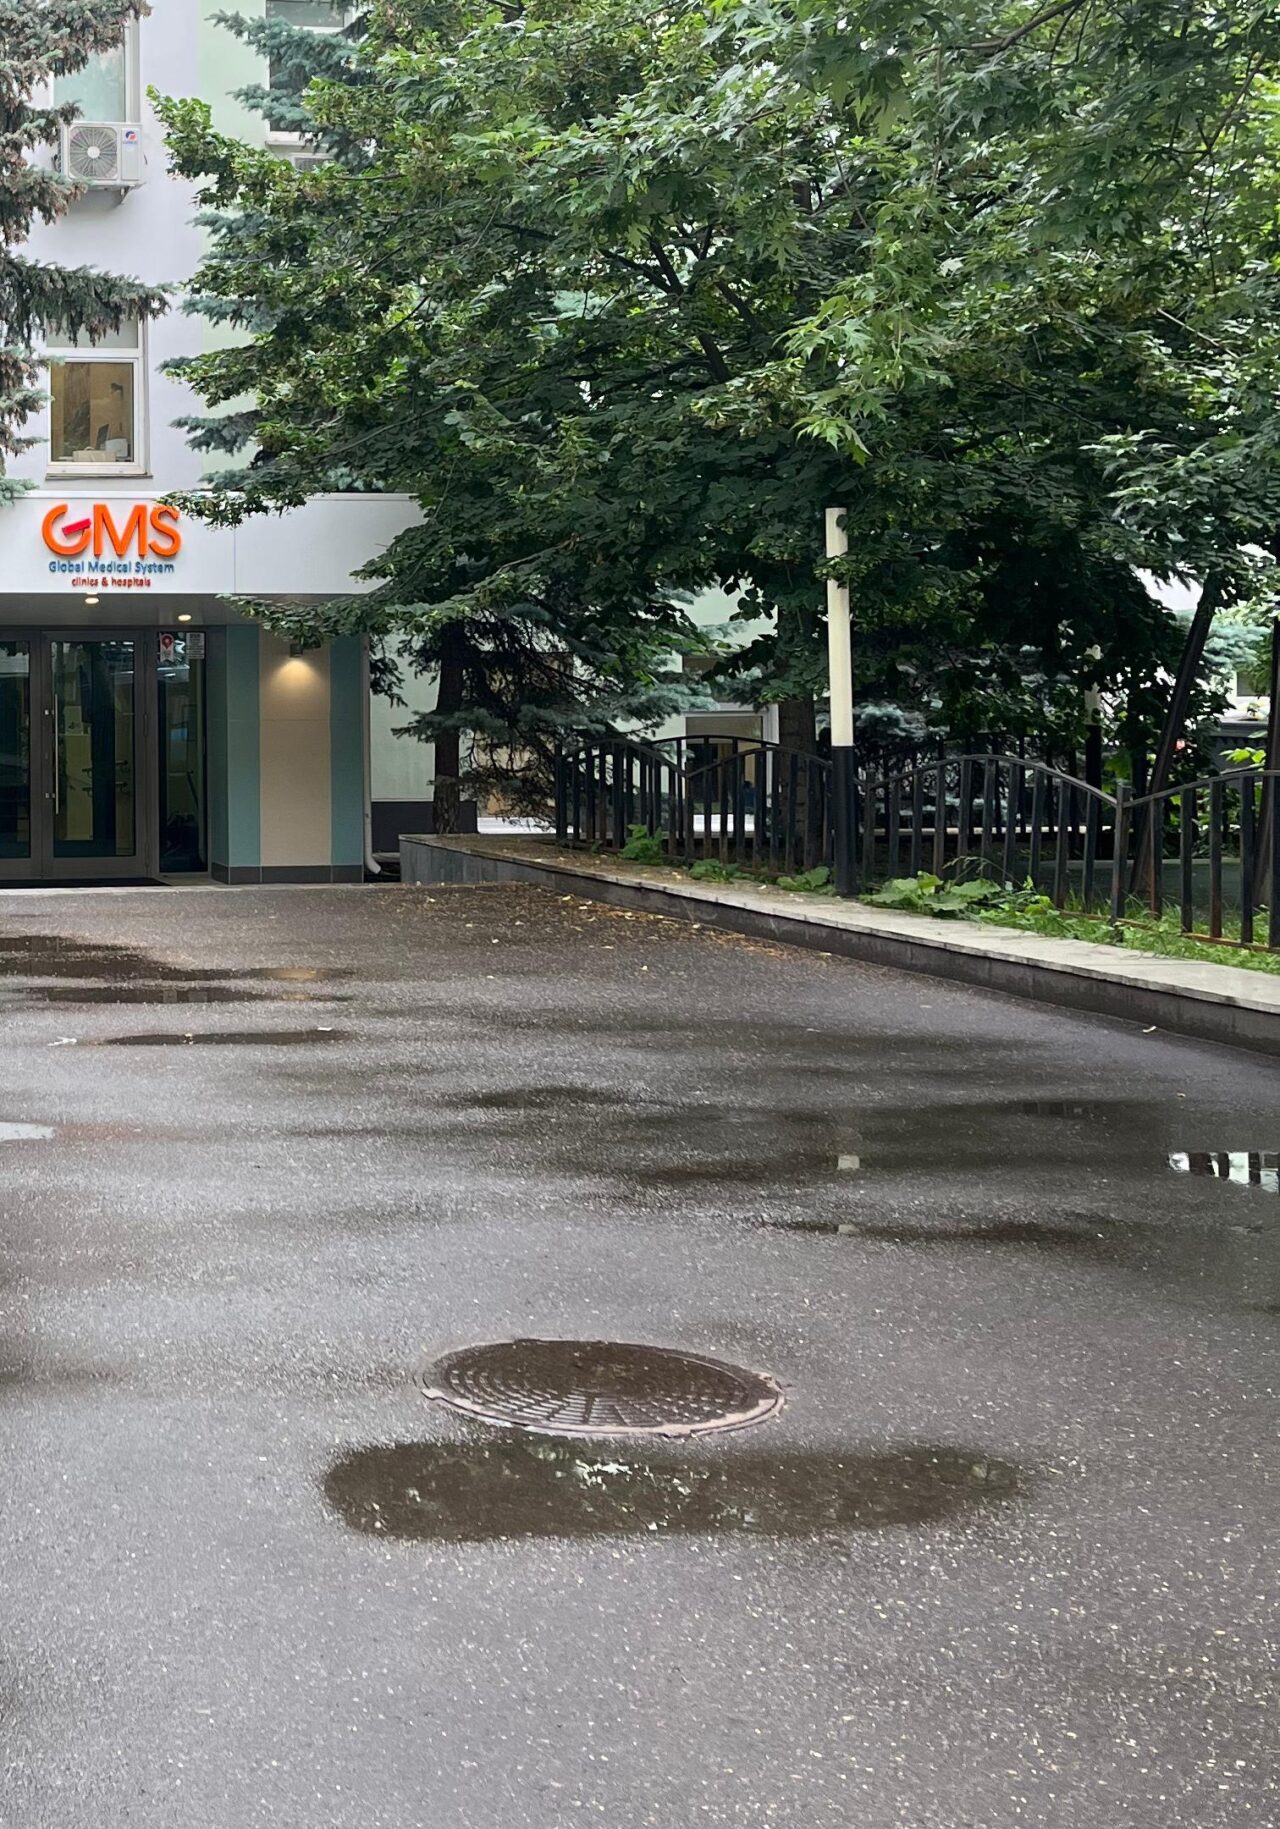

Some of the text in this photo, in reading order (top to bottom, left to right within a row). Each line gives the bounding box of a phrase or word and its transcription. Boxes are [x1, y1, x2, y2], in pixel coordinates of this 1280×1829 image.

[42, 503, 182, 557] GMS
[48, 561, 175, 575] Global Medical System
[71, 577, 151, 589] clinics & hospitals
